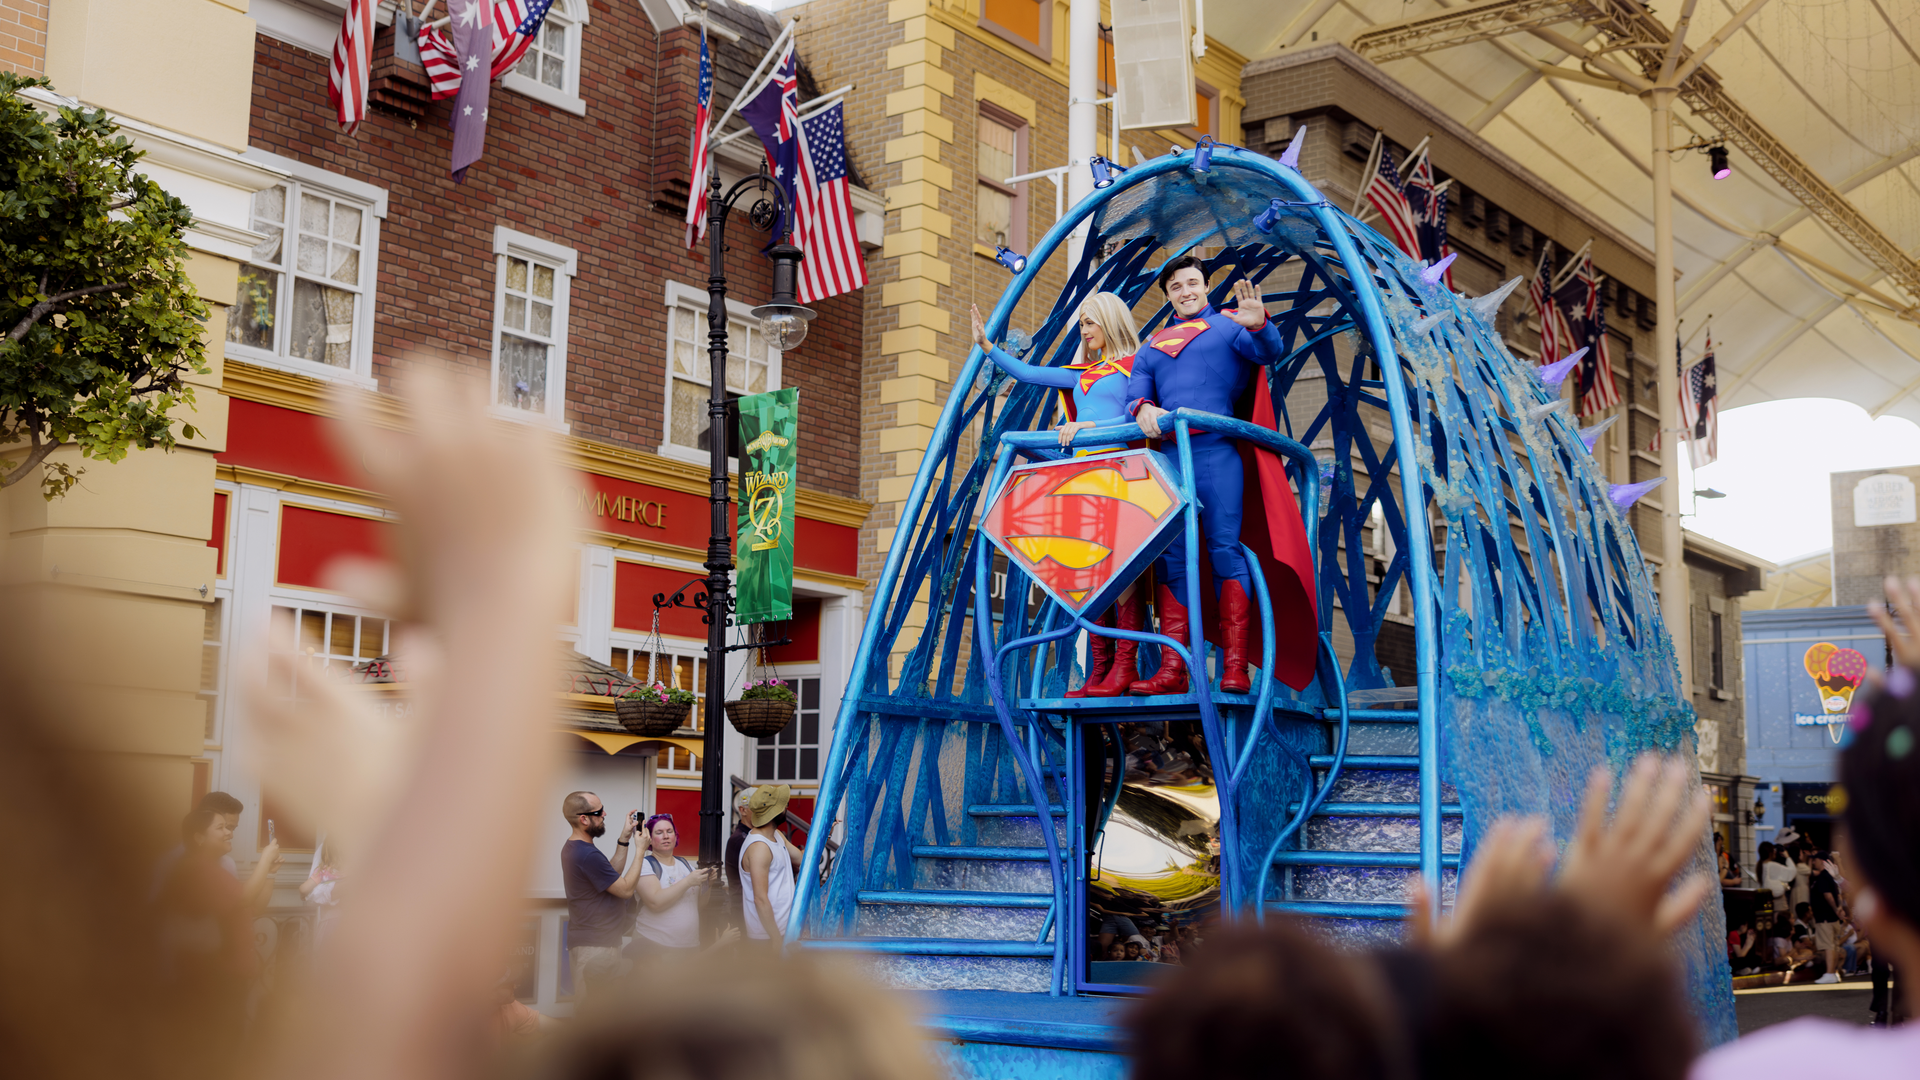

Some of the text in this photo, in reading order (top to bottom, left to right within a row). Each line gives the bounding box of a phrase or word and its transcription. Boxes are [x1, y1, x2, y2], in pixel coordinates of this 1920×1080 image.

[745, 470, 788, 497] WIZARD
[561, 485, 668, 529] OMMERCE
[1795, 712, 1855, 725] ice cream
[1804, 794, 1841, 804] CONNO
[509, 945, 535, 956] LAND
